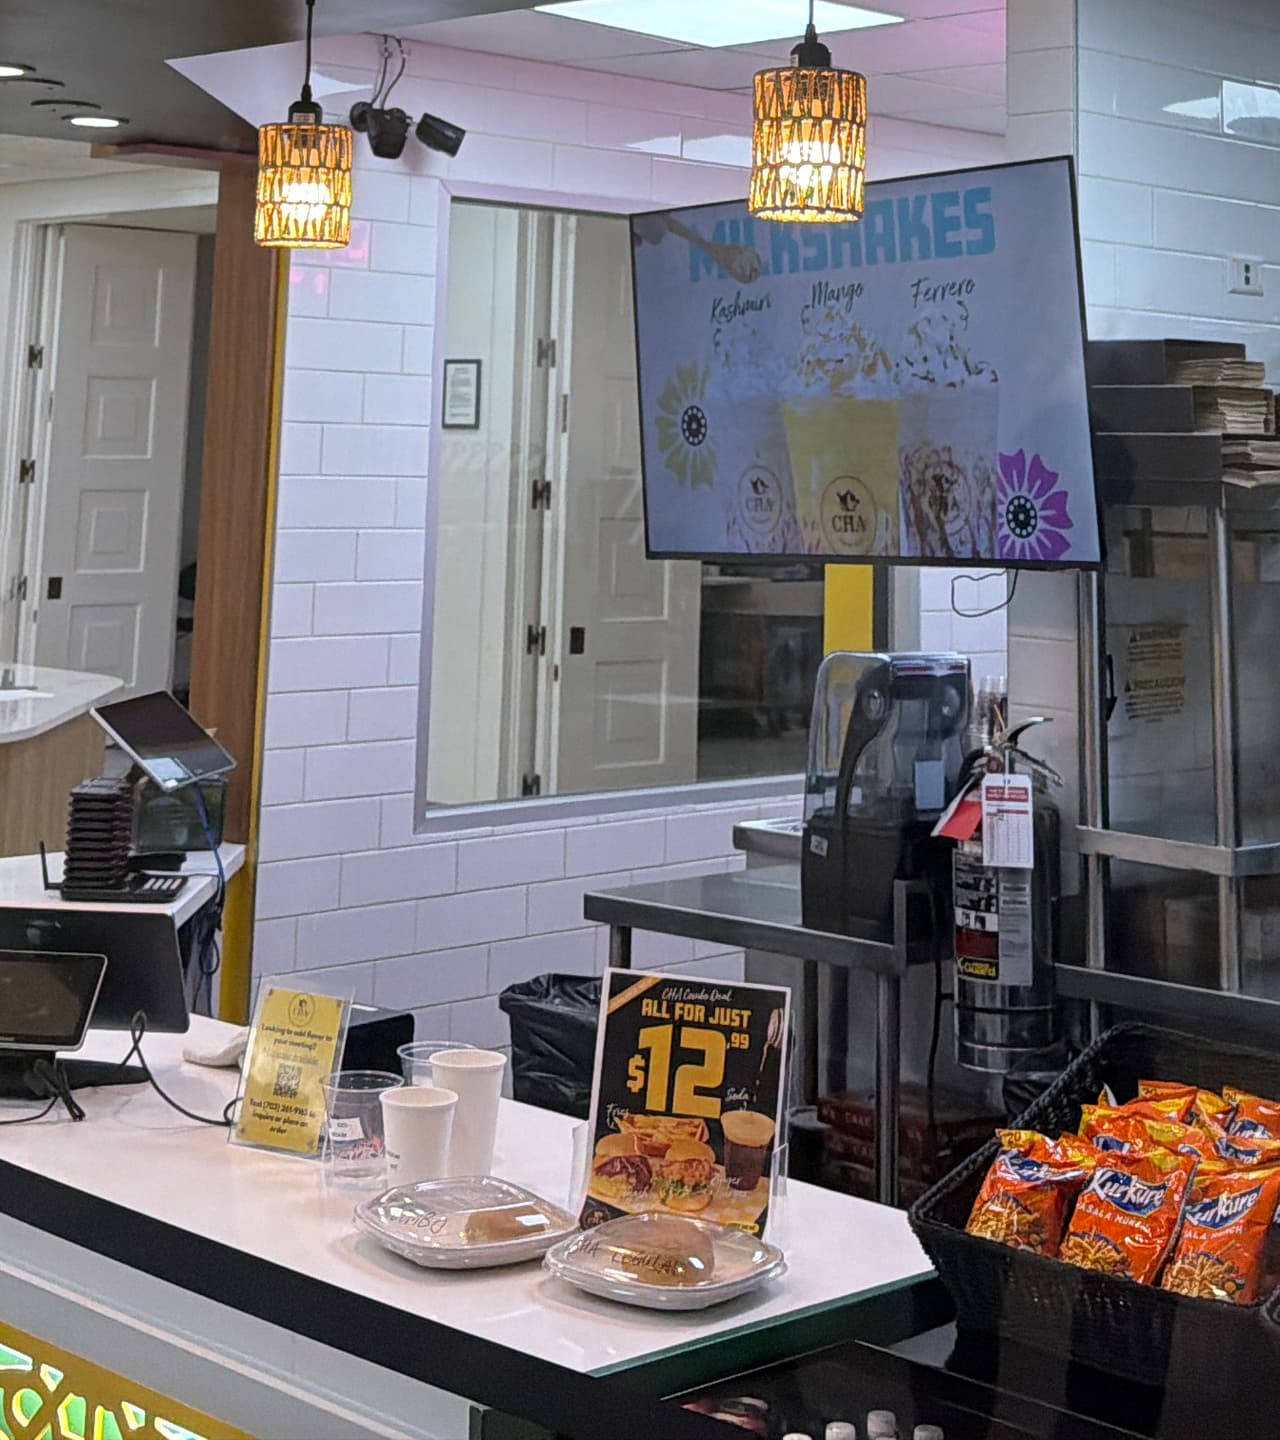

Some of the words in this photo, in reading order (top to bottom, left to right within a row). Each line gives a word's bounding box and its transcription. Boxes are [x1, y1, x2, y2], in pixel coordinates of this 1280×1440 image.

[810, 280, 864, 311] Mango
[911, 277, 975, 303] Ferrero
[832, 514, 867, 533] CHA
[642, 998, 670, 1019] ALL
[674, 1002, 706, 1023] FOR
[708, 1007, 752, 1029] JUST
[1084, 1167, 1165, 1206] Kurkure
